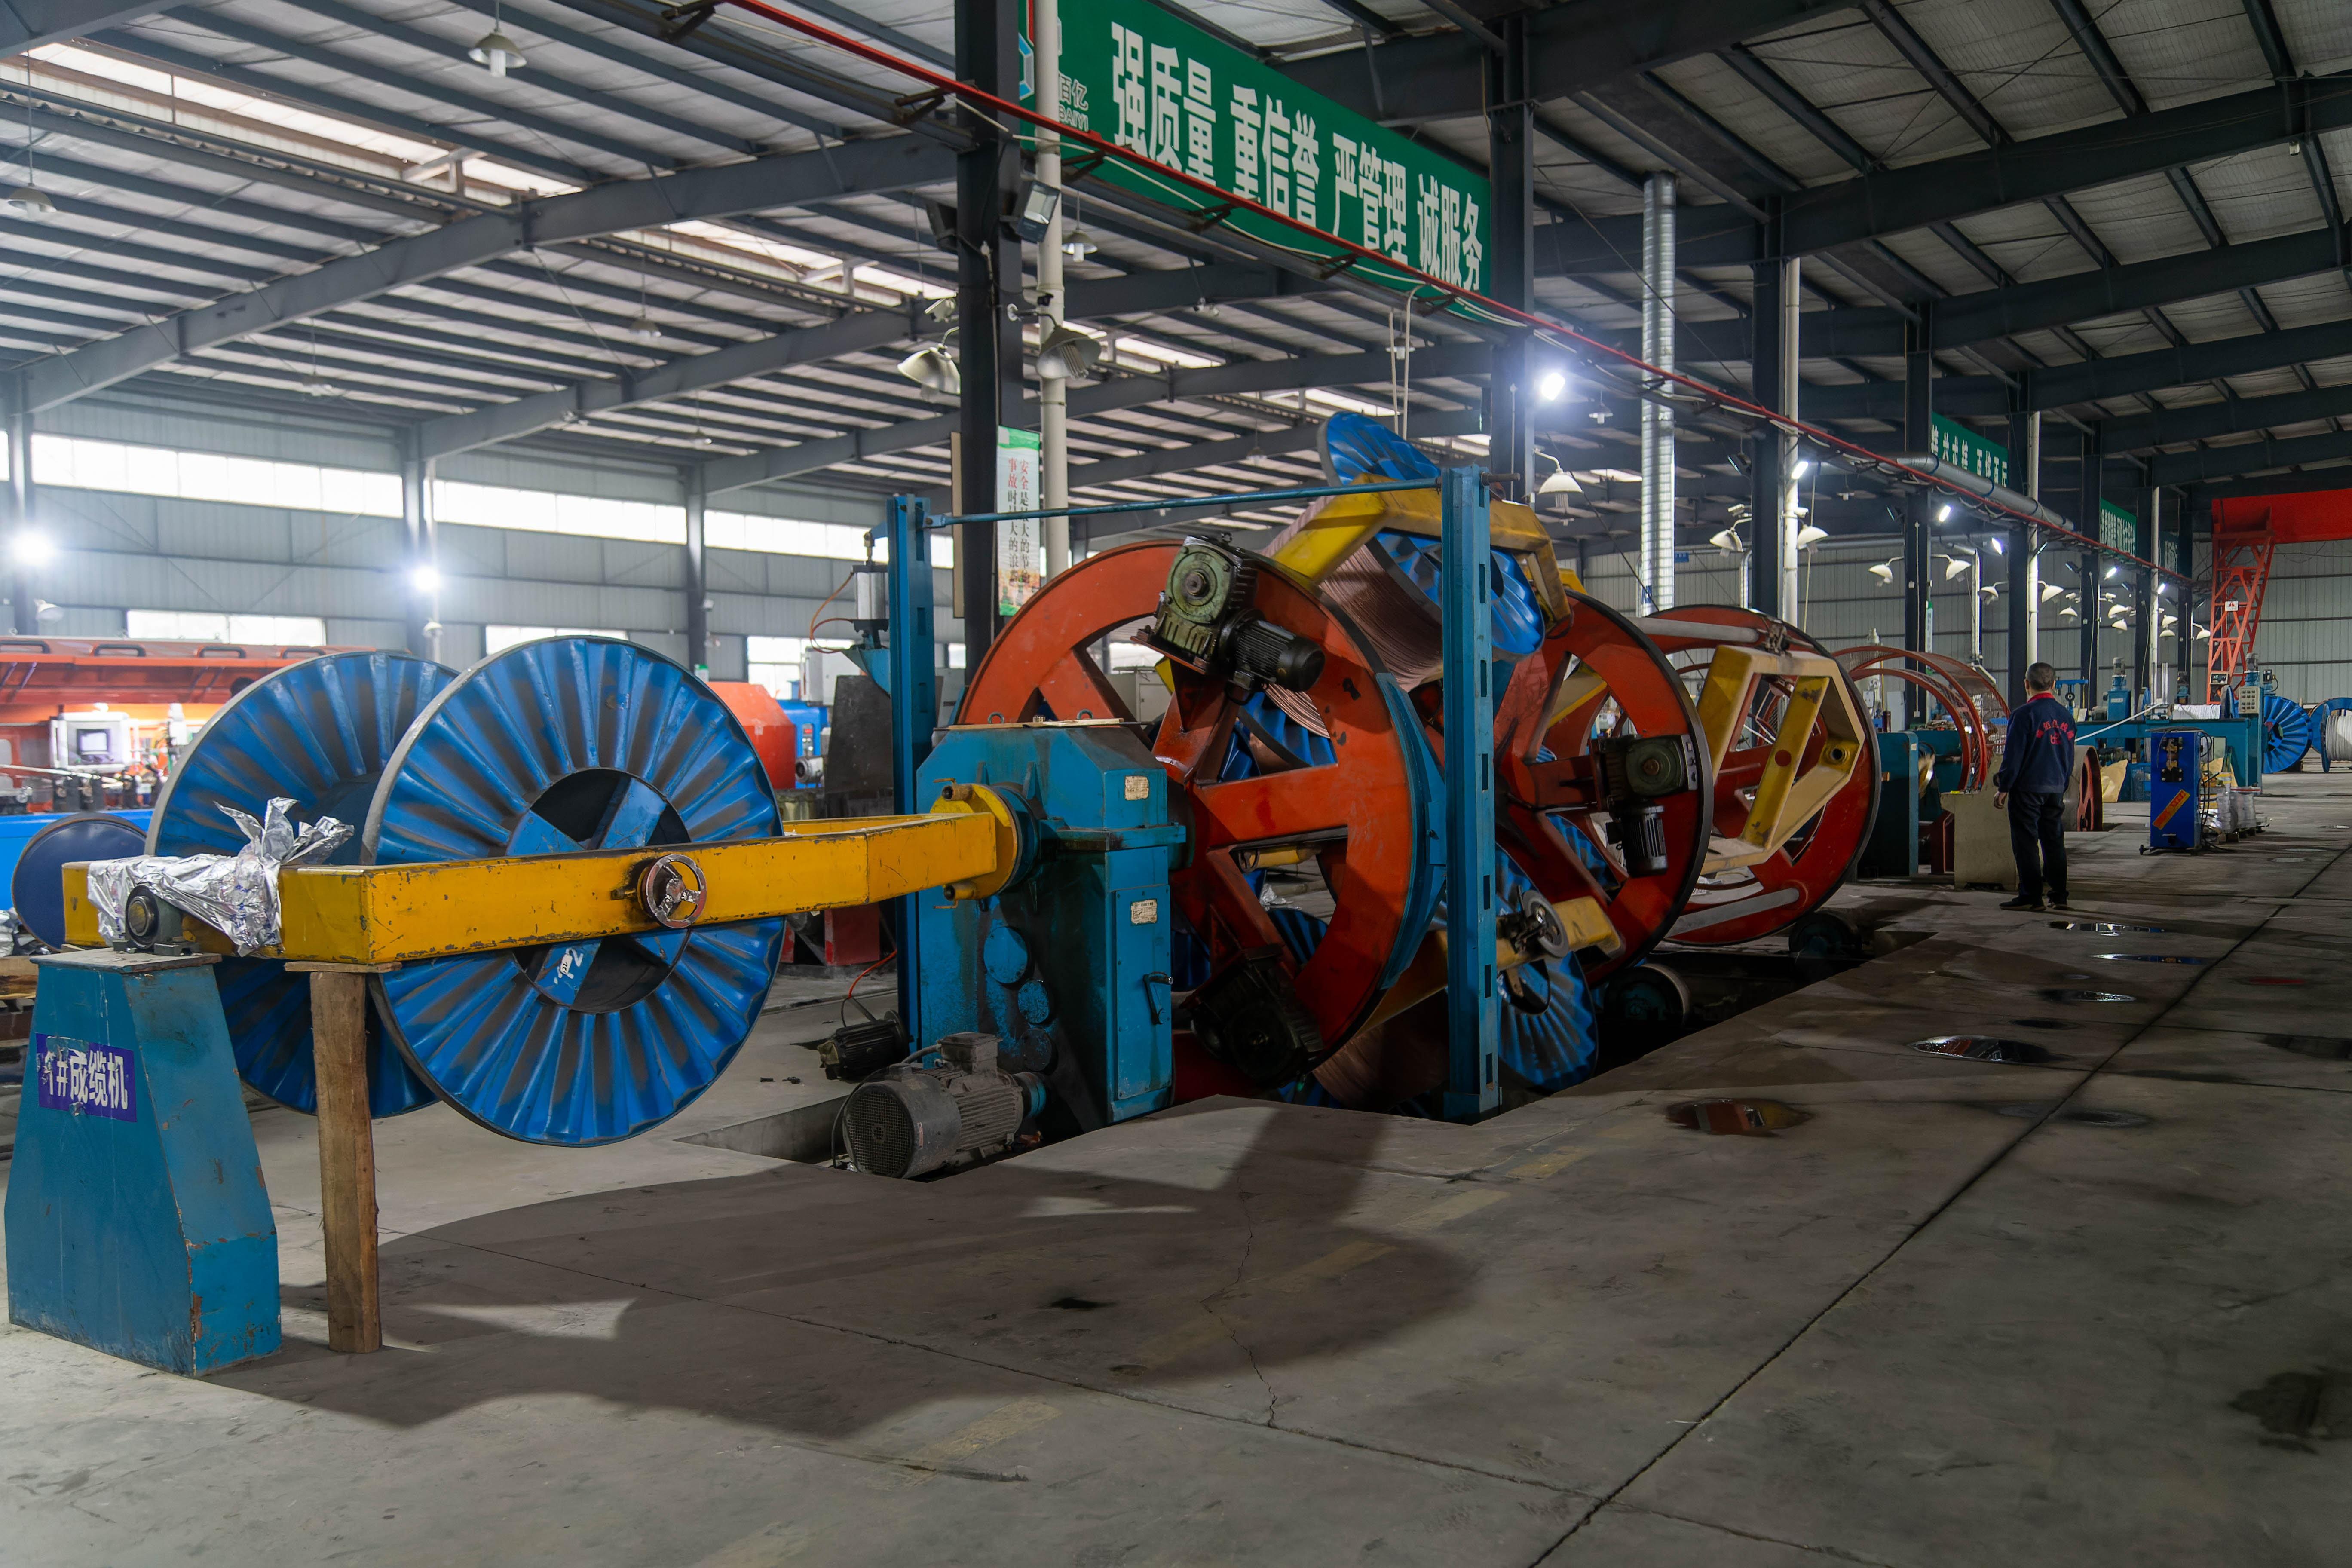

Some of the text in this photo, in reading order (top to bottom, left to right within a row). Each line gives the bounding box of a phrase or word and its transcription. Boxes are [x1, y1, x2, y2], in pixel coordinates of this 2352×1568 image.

[1059, 104, 1089, 132] BAIYI
[1111, 21, 1483, 291] 强质量 重信誉 严管理 诚服务
